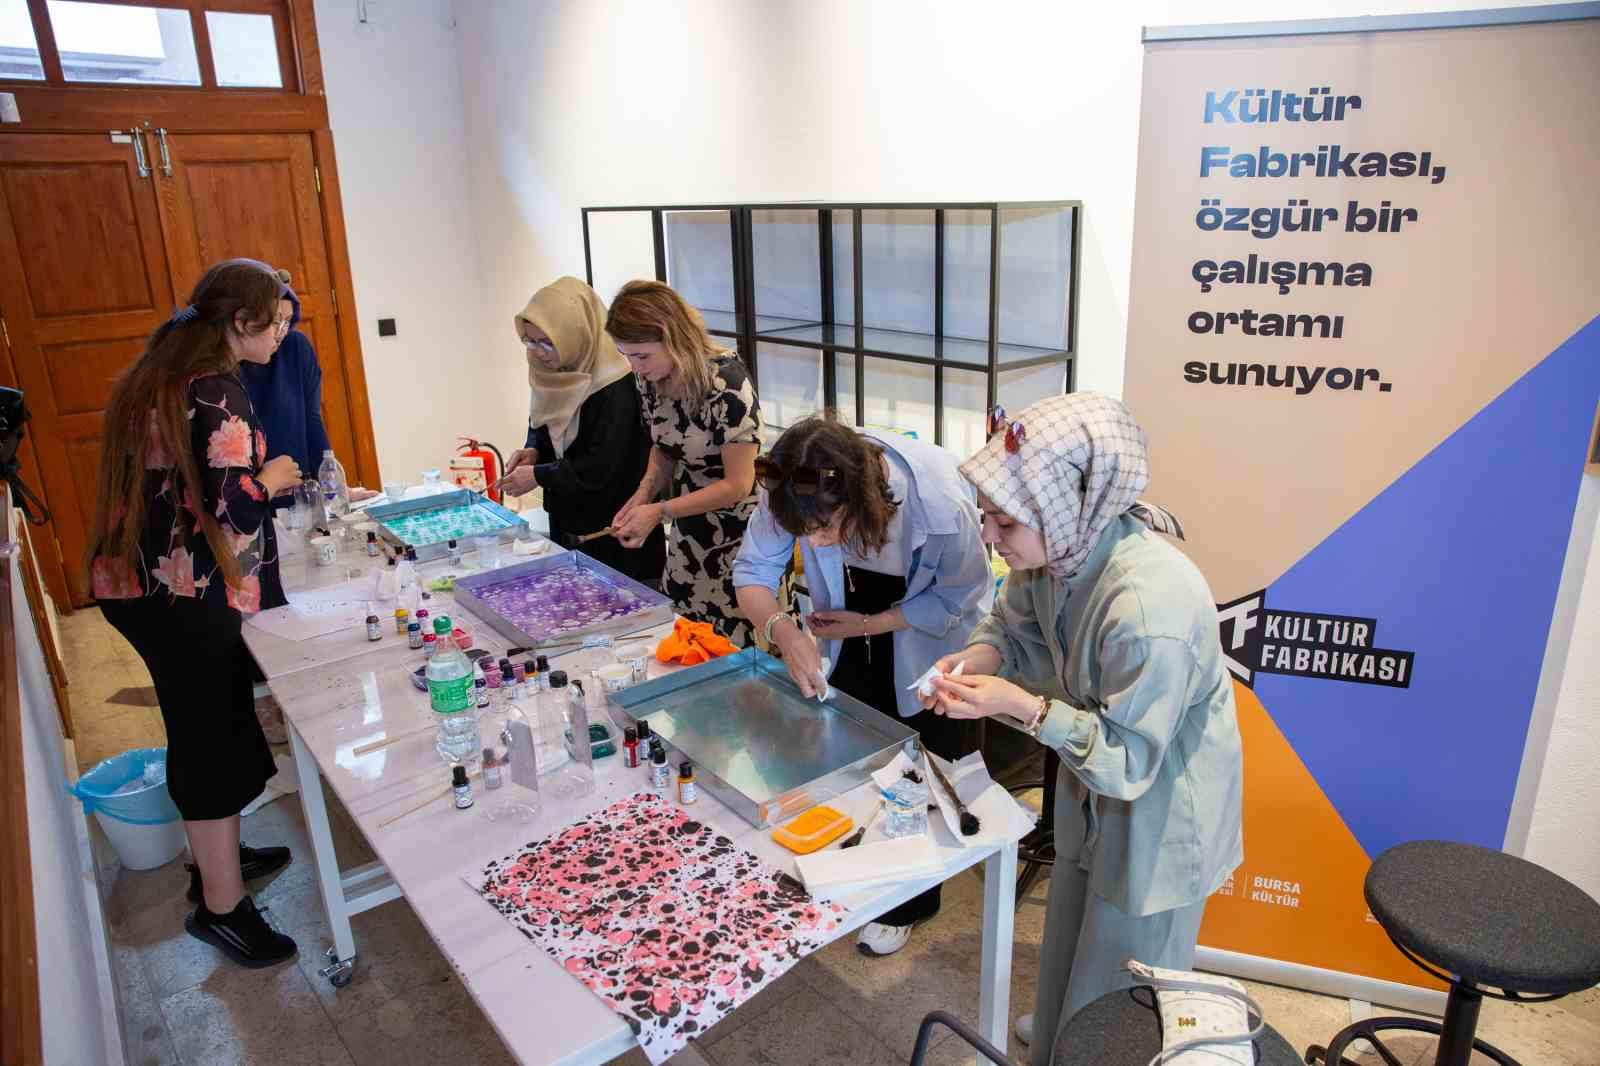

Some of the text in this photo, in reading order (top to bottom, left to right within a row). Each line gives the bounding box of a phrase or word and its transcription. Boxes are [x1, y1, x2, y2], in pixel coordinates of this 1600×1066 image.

[1203, 86, 1362, 124] Kültür
[1199, 145, 1447, 184] Fabrikası,
[1195, 199, 1418, 239] özgür bir
[1191, 253, 1373, 295] çalışma
[1187, 309, 1344, 339] ortamı
[1183, 360, 1393, 395] sunuyor.
[1253, 876, 1301, 894] BURSA
